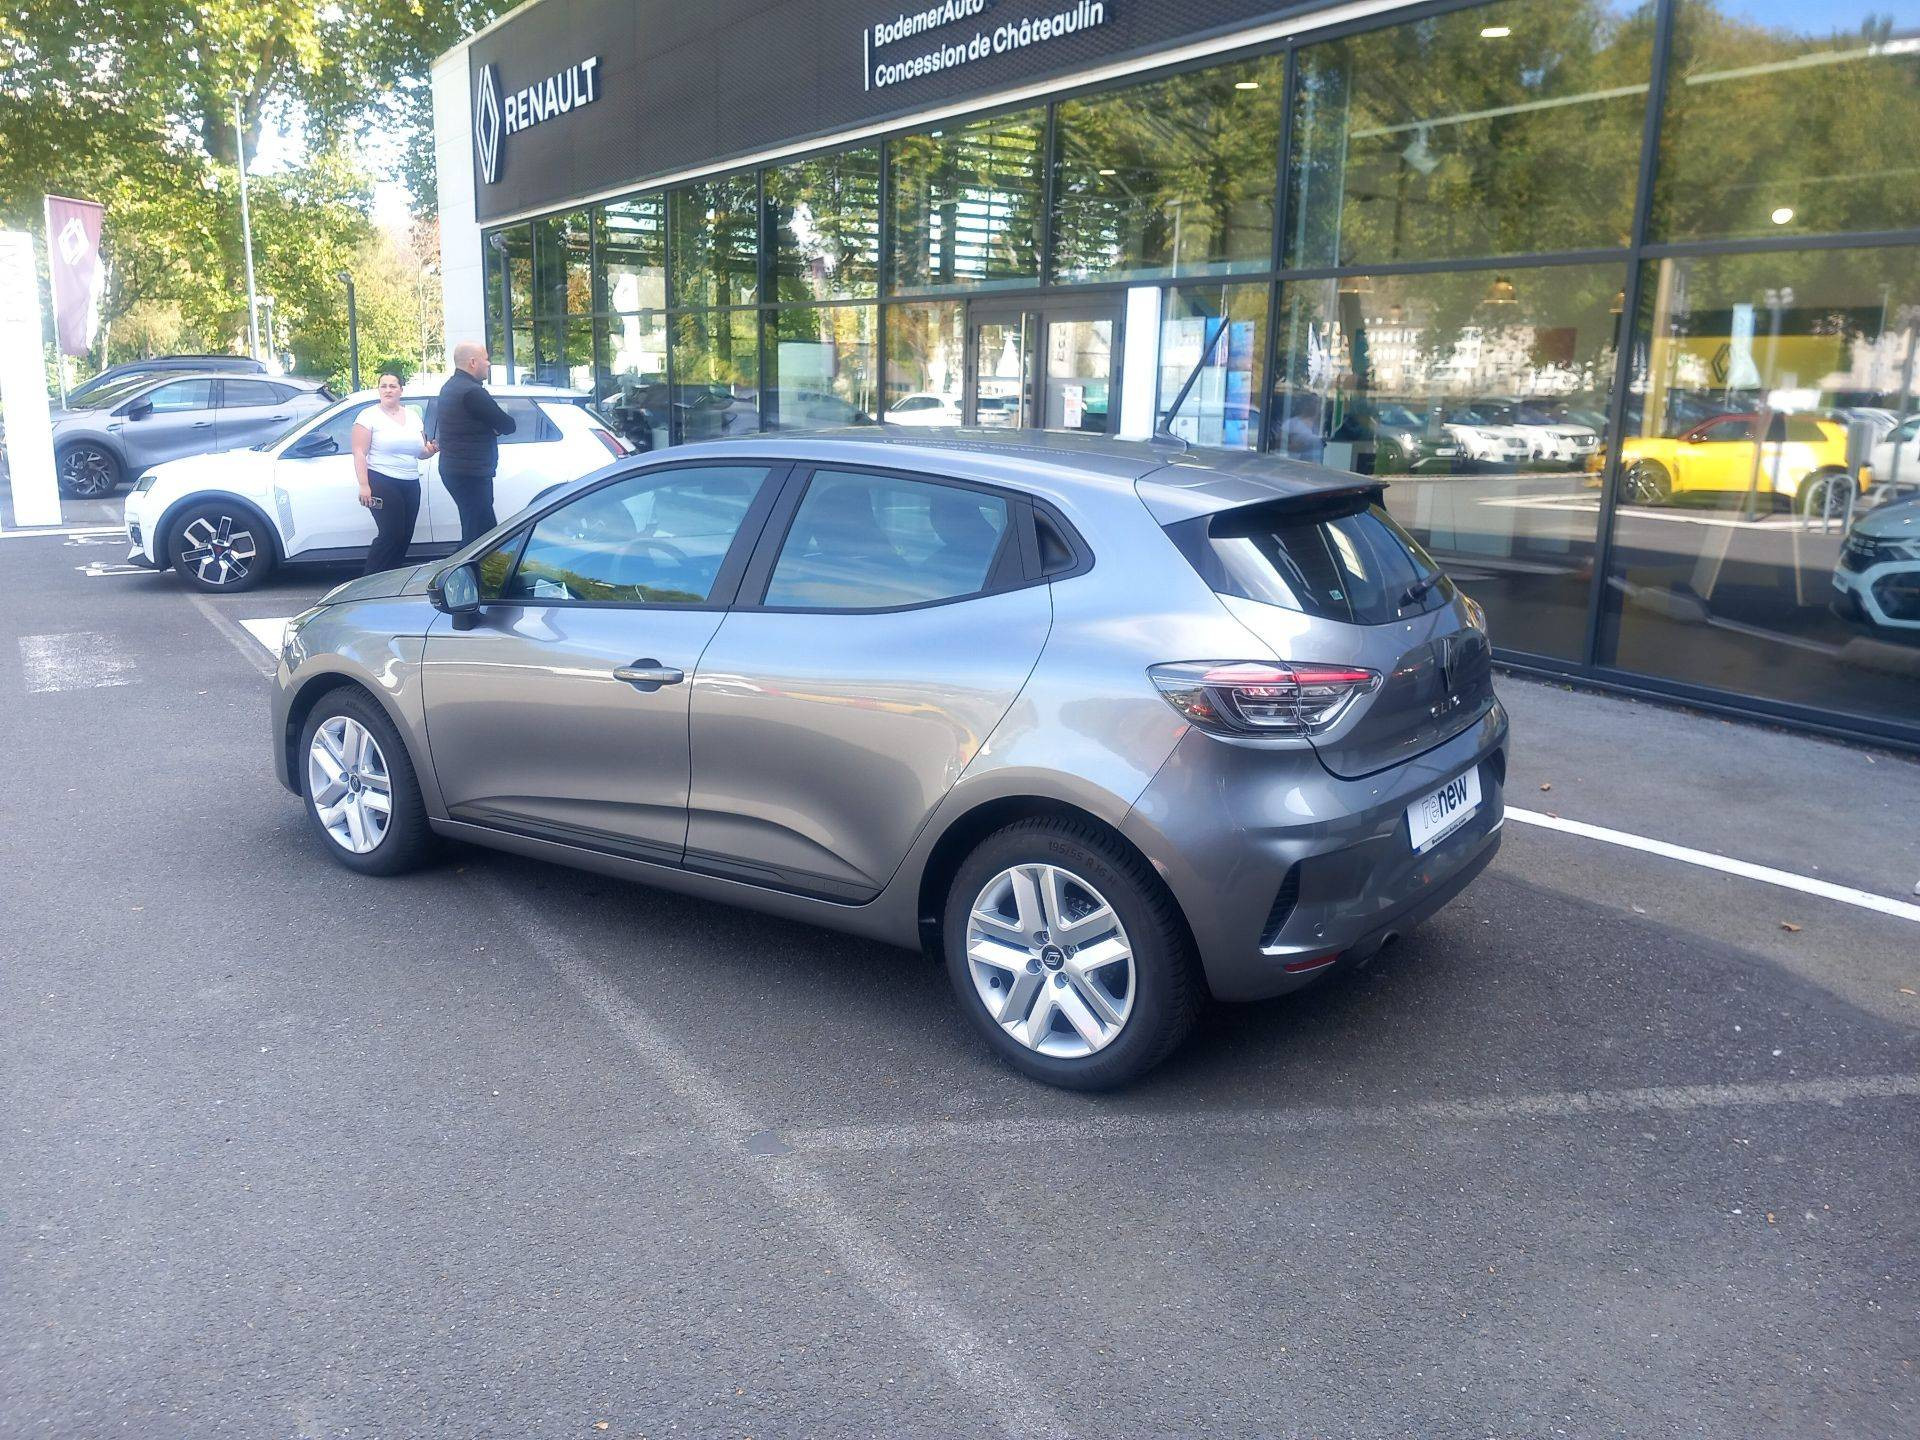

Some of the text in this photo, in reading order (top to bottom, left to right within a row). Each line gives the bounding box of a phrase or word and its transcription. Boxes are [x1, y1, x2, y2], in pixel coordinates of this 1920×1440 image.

[874, 0, 984, 47] BodemerAuto
[874, 0, 1104, 88] Concession de Châteaulin
[504, 56, 597, 135] RENAULT
[1422, 775, 1467, 829] renew
[1048, 840, 1084, 860] 195/55
